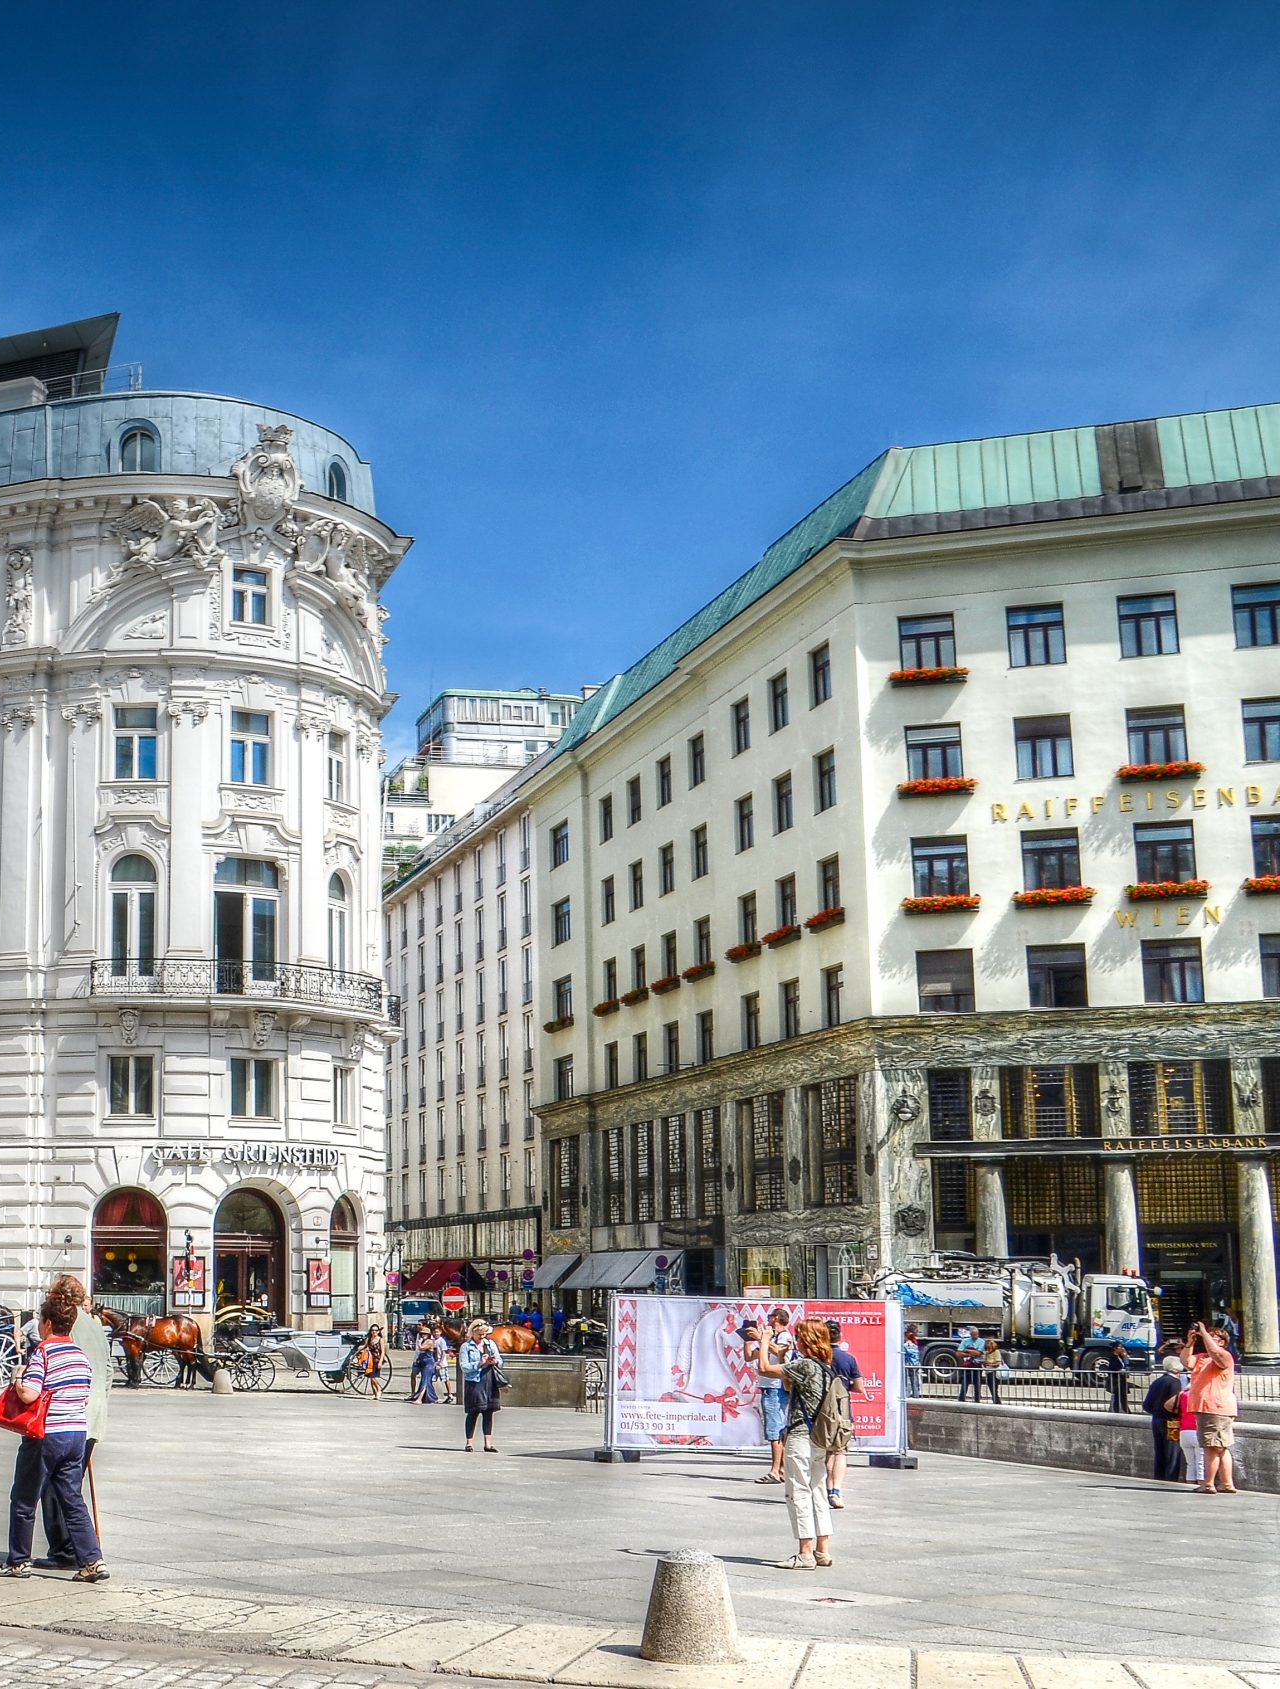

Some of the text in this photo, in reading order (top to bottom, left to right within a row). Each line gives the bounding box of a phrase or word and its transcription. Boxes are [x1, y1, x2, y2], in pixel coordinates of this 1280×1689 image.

[1114, 906, 1222, 928] WIEN
[1103, 1137, 1267, 1151] RAIFFEISENBANK
[855, 1415, 882, 1423] 2016
[620, 1421, 675, 1431] 01/533 90 31
